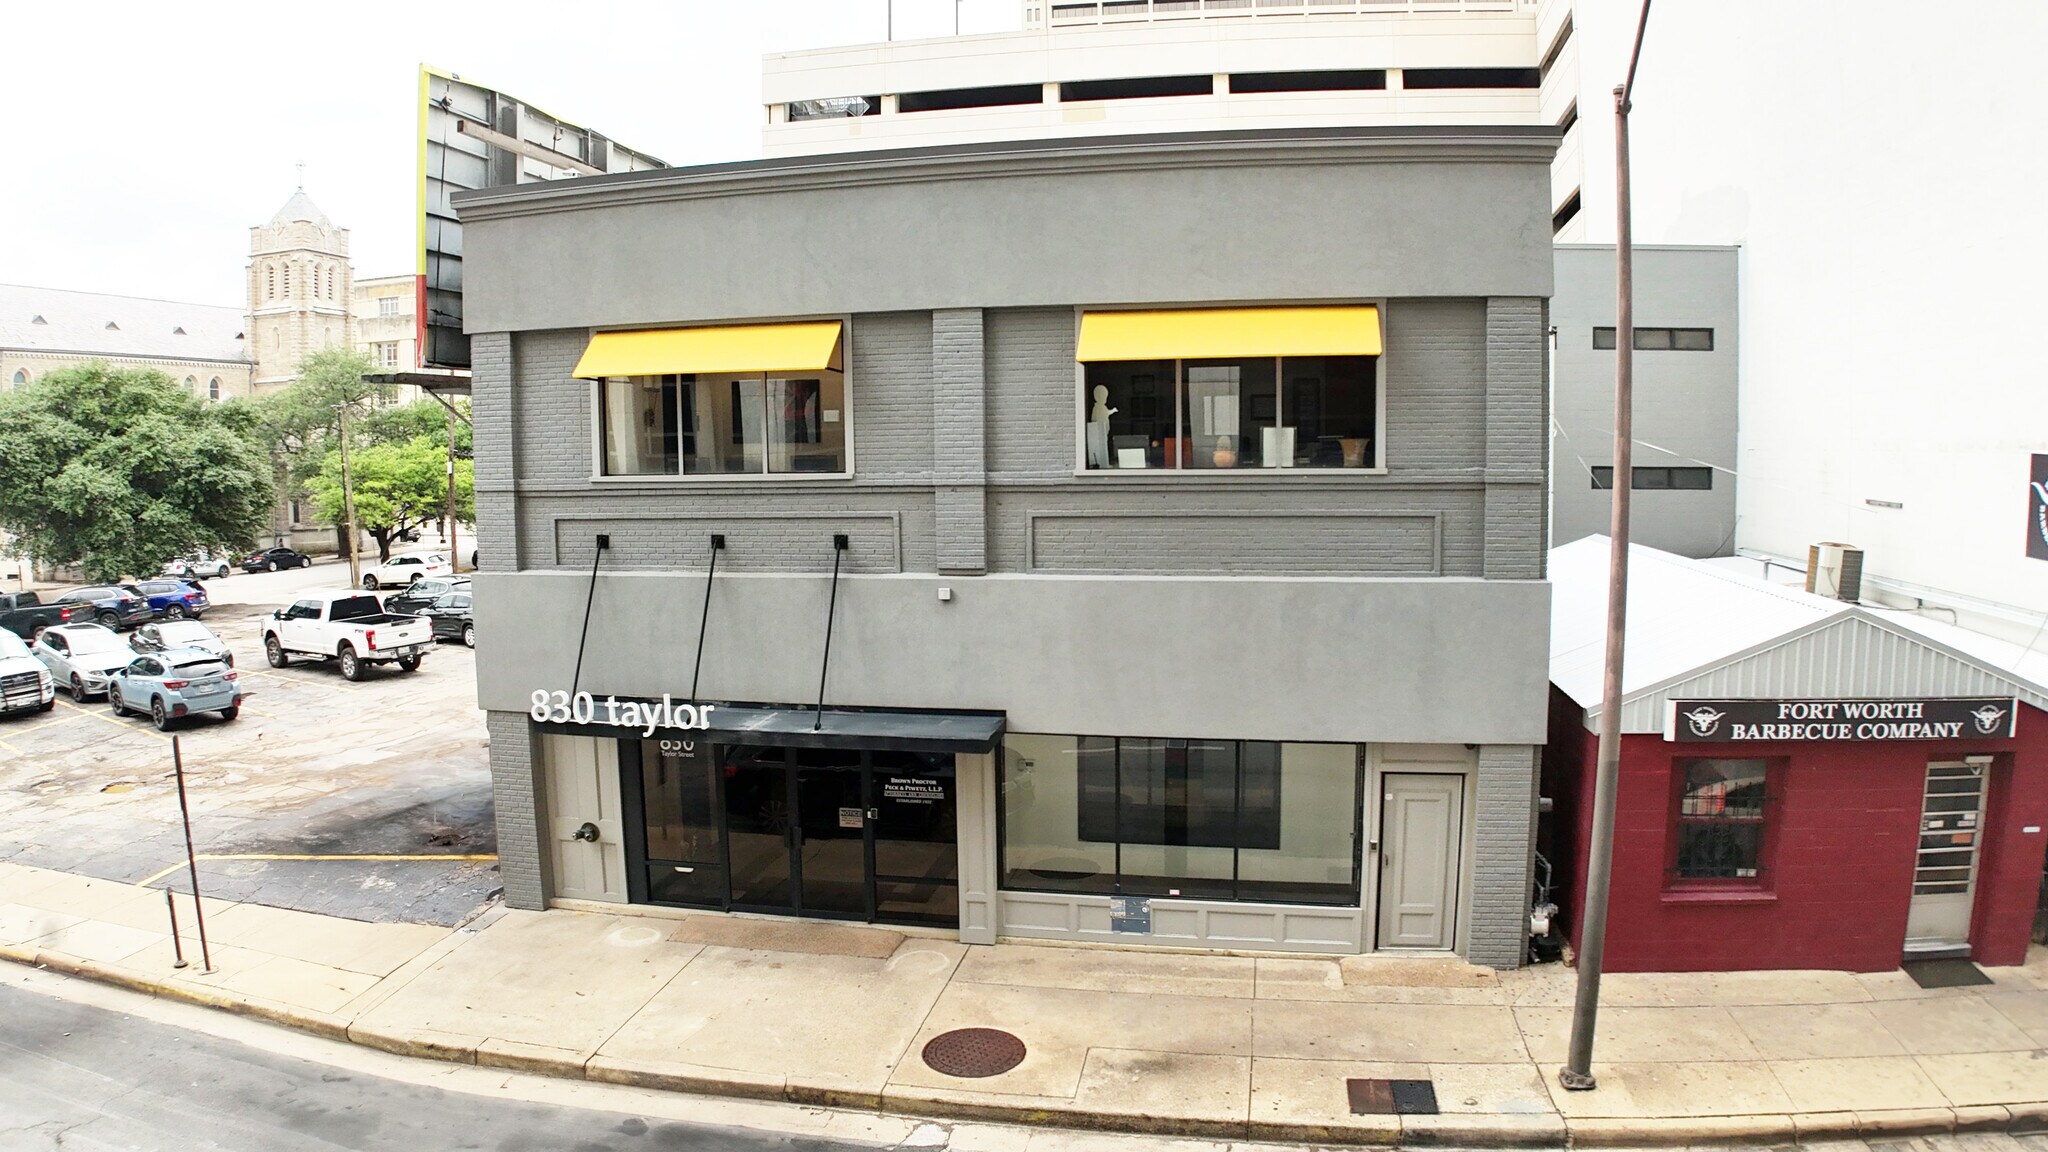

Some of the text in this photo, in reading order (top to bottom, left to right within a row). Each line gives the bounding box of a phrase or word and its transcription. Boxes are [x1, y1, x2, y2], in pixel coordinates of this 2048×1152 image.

[530, 689, 715, 738] 830 taylor
[1777, 702, 1925, 720] FORT WORTH
[1731, 722, 1964, 740] BARBECUE COMPANY
[661, 751, 677, 759] Taylor
